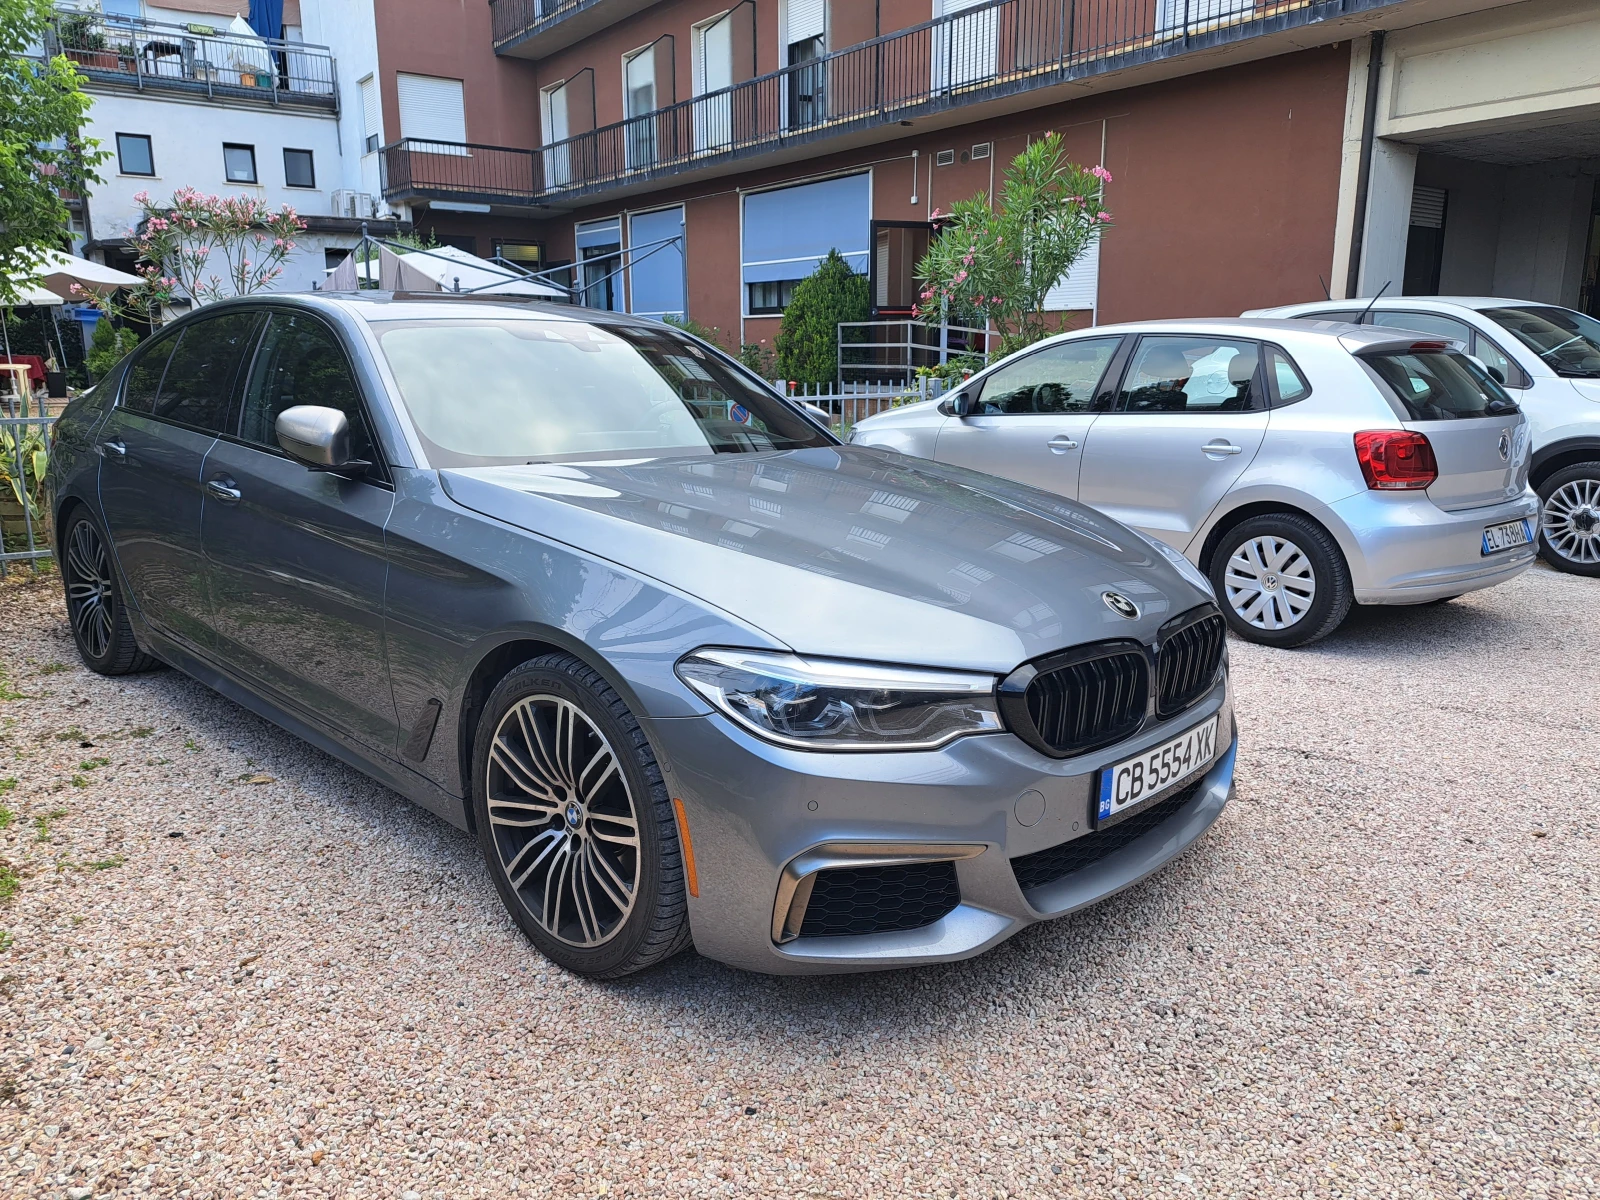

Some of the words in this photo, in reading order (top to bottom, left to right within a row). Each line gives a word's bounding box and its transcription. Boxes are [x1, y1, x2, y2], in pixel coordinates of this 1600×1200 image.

[1485, 529, 1500, 549] EL
[1115, 761, 1144, 806] CB
[1148, 735, 1193, 790] 5554
[1194, 722, 1214, 766] XK
[1099, 799, 1110, 812] BG
